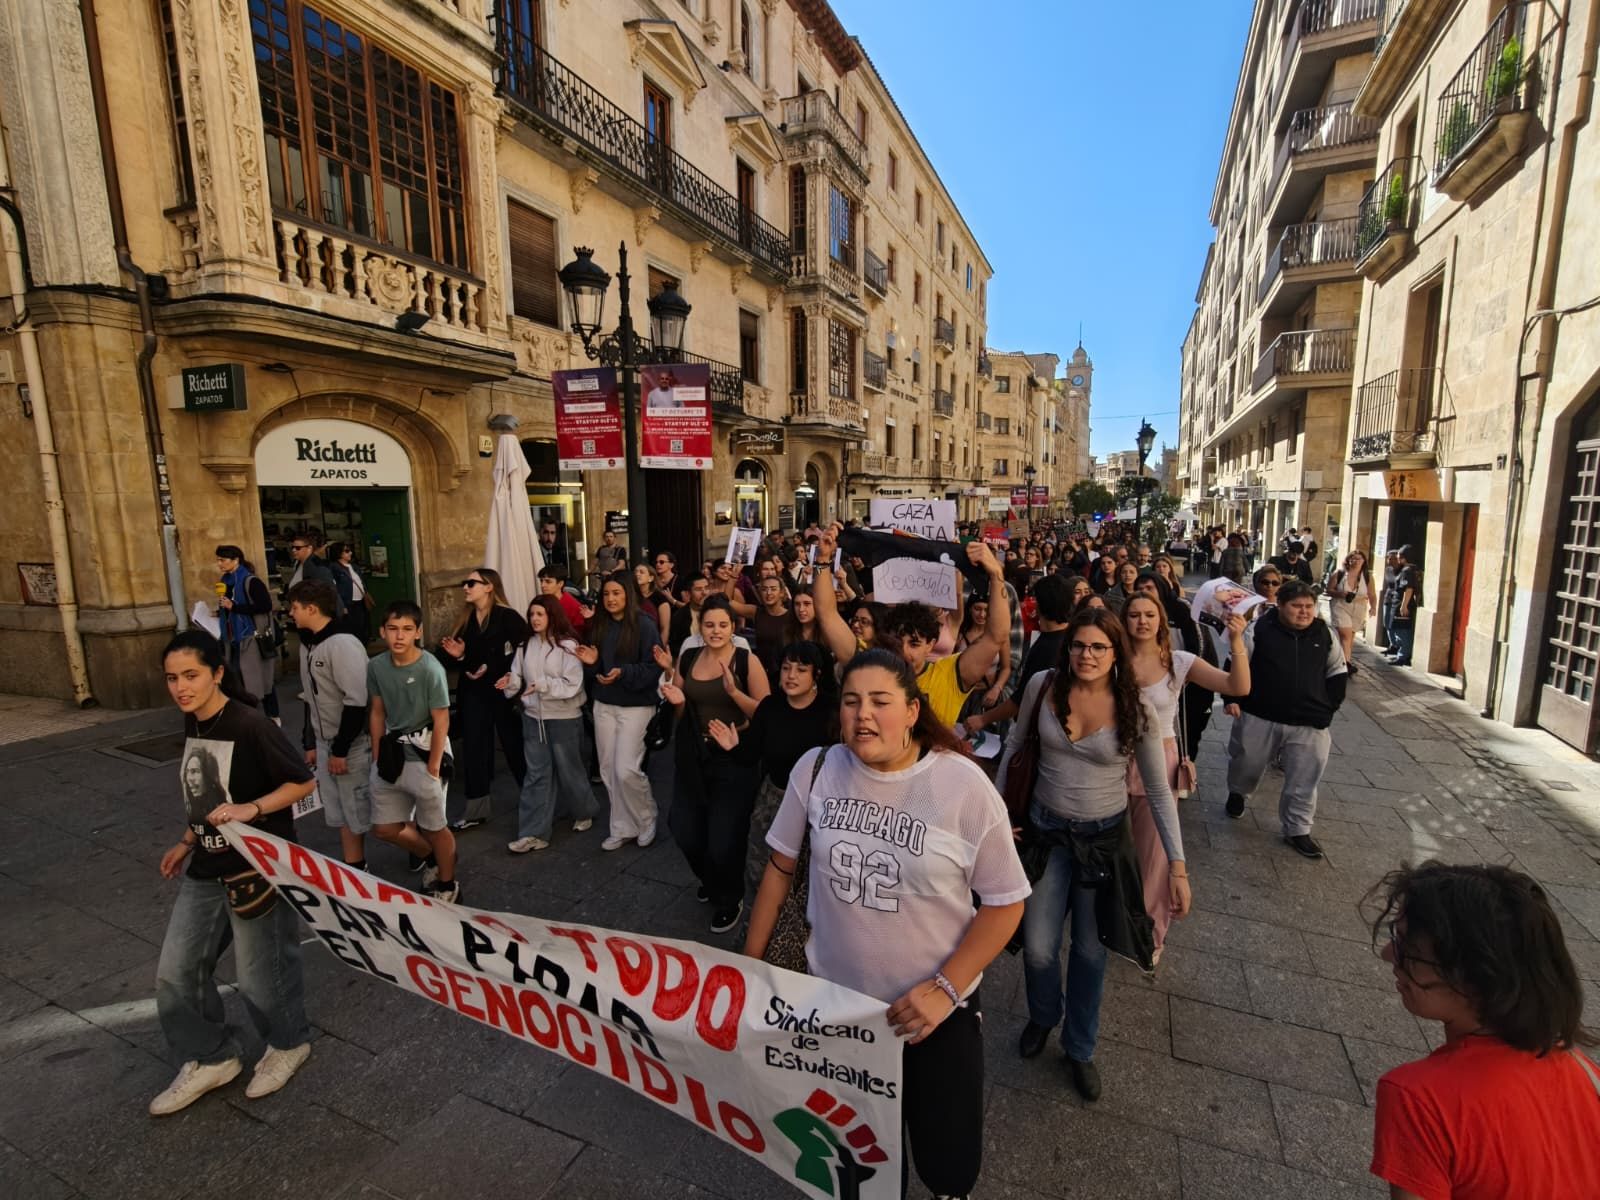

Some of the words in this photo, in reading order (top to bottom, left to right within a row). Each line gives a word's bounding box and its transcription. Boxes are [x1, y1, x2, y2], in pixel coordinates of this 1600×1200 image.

[187, 371, 228, 392] Richetti
[195, 395, 224, 405] ZAPATOS
[294, 437, 378, 464] Richetti
[310, 468, 368, 479] ZAPATOS
[892, 503, 935, 521] GAZA
[819, 797, 927, 857] CHICAGO
[829, 839, 902, 913] 92
[277, 884, 442, 962] PARA
[546, 925, 748, 1053] TODO
[315, 929, 398, 984] EL
[404, 954, 767, 1155] GENOCIDIO
[763, 995, 876, 1044] Sindicato
[791, 1034, 821, 1051] de
[764, 1044, 897, 1099] Estudiantes
